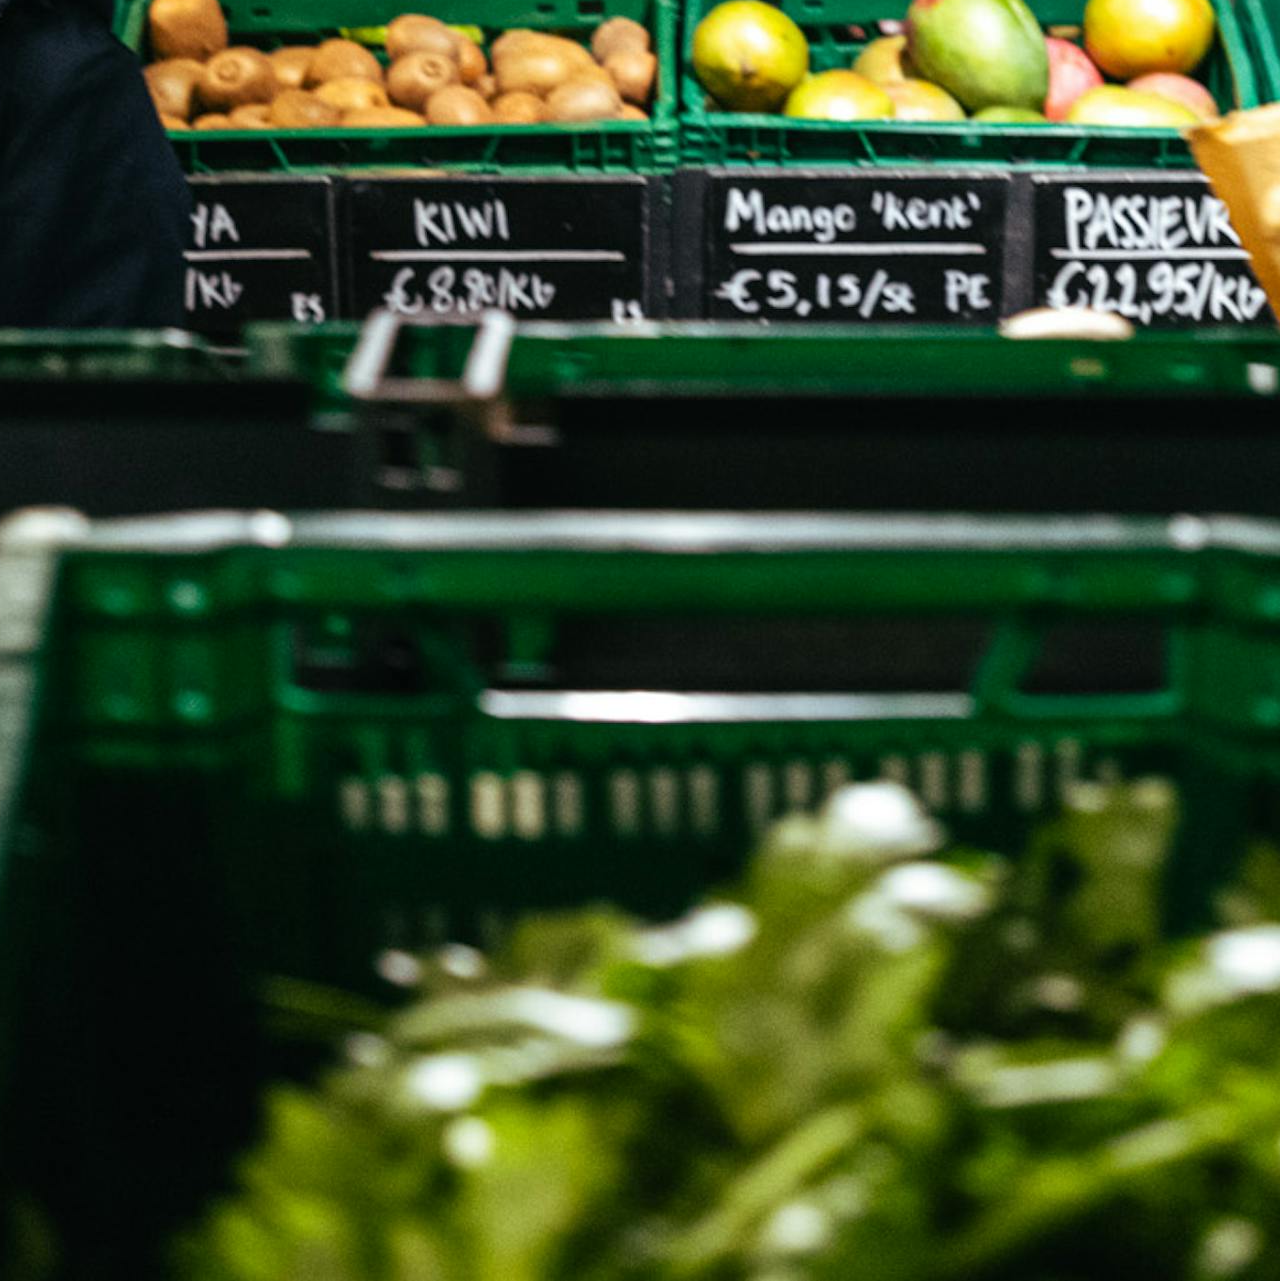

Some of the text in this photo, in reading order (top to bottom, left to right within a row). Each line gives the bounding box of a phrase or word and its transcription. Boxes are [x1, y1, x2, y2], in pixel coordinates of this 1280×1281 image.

[414, 198, 510, 247] KIWI
[724, 187, 857, 243] Mango
[1063, 187, 1242, 251] PASSIEVR
[945, 269, 991, 312] PE
